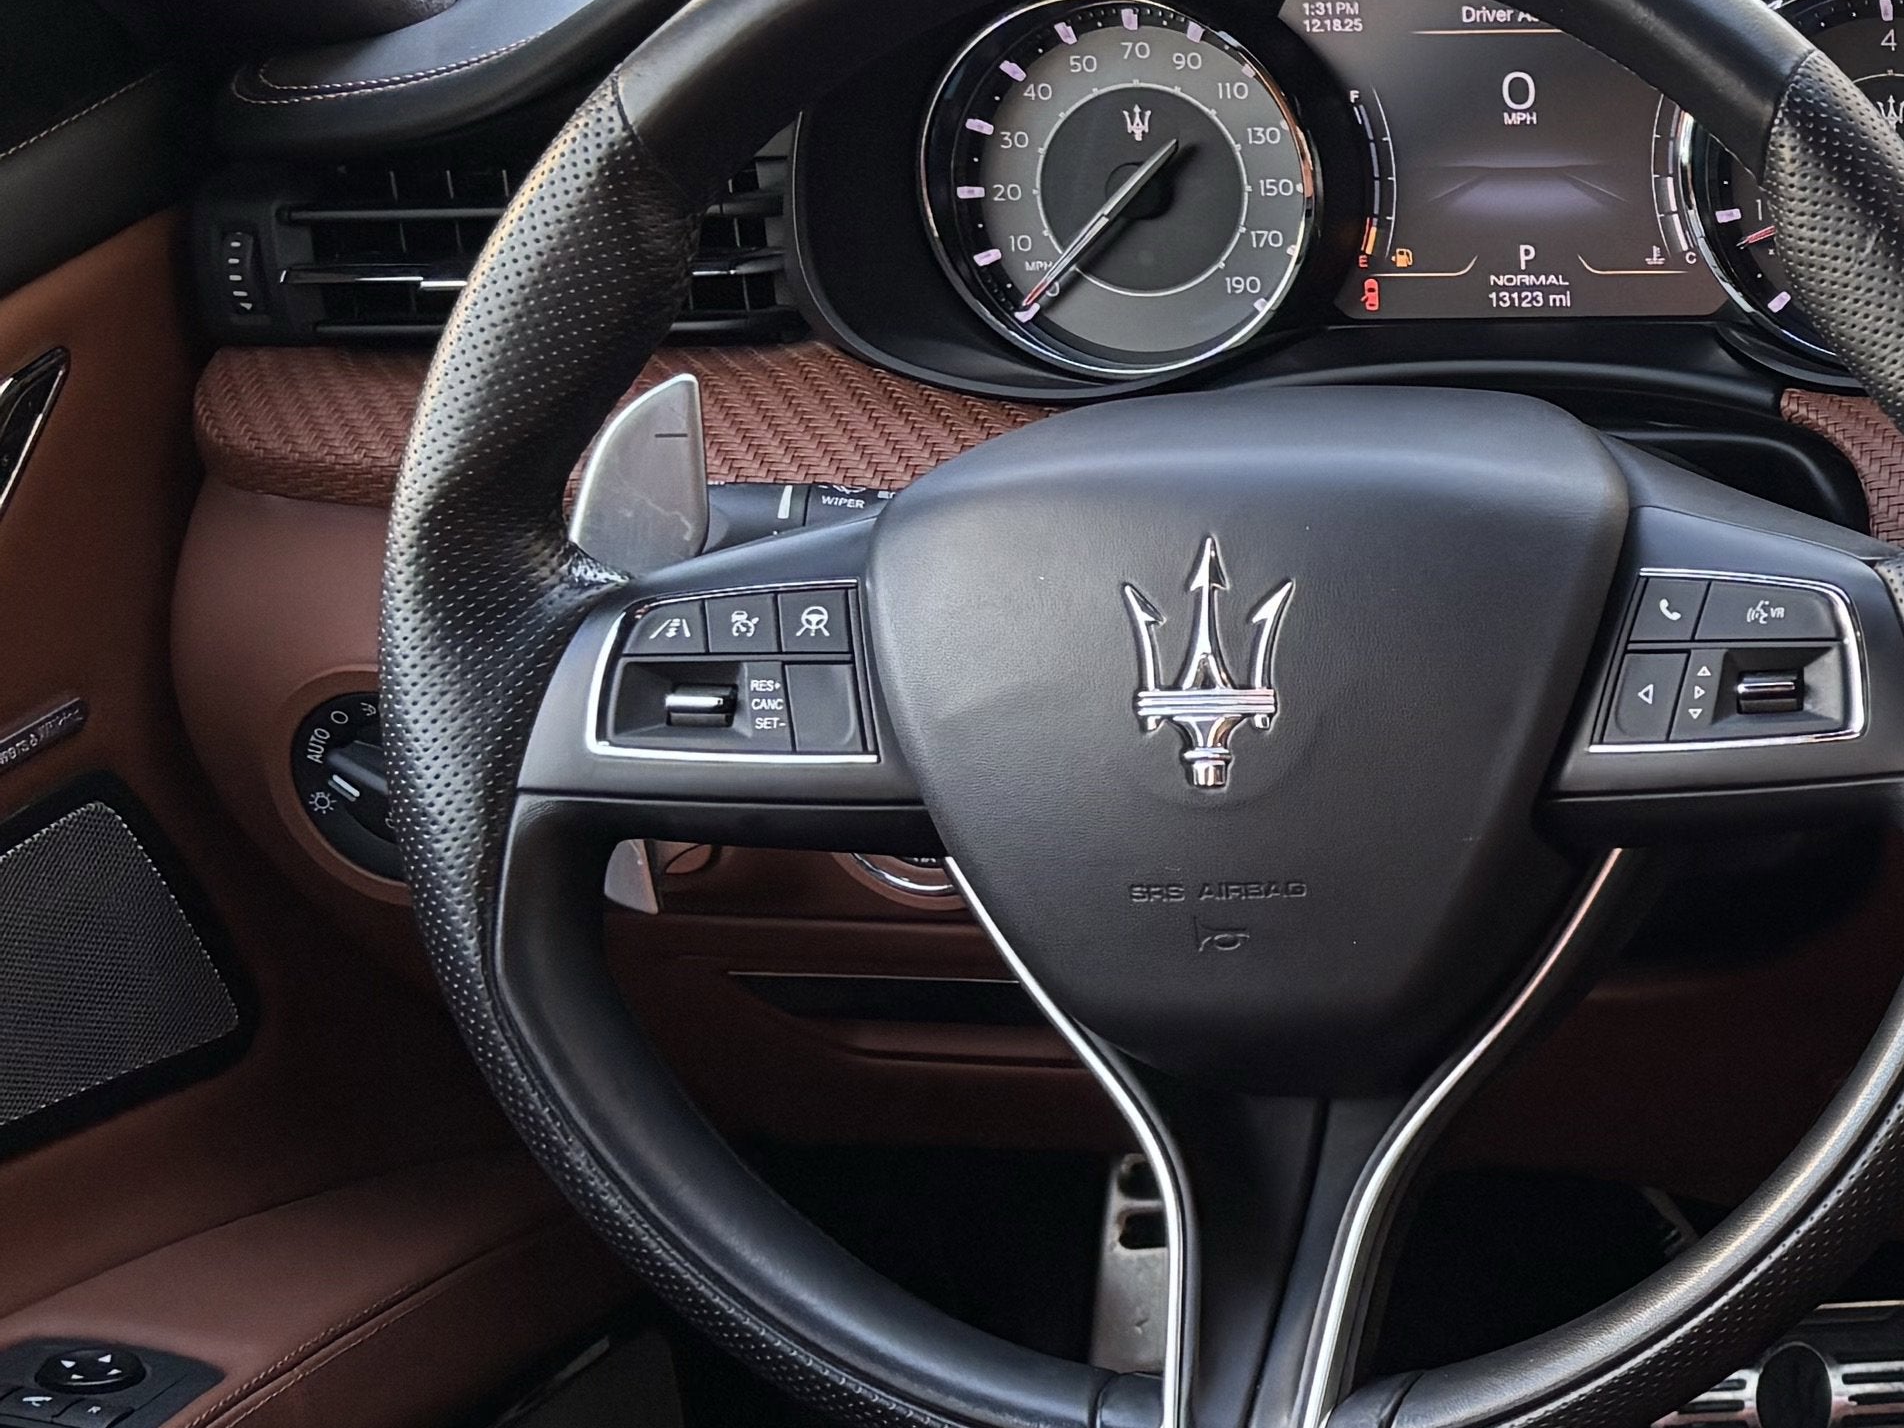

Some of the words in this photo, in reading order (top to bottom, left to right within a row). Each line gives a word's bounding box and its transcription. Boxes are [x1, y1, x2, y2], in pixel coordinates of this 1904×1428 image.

[1303, 2, 1334, 16] 1:31
[1336, 2, 1359, 15] PM
[1462, 6, 1513, 23] Driver
[1303, 19, 1363, 33] 12.18.25
[1881, 29, 1898, 52] 4
[1121, 42, 1150, 59] 70
[1069, 55, 1098, 73] 50
[1172, 52, 1202, 70] 90
[1023, 83, 1052, 101] 40
[1216, 81, 1248, 100] 110
[1350, 90, 1360, 104] F
[1501, 71, 1536, 110] 0
[1503, 112, 1537, 125] MPH
[1000, 131, 1029, 149] 30
[1248, 127, 1281, 145] 130
[993, 184, 1022, 201] 20
[1259, 178, 1294, 196] 150
[1009, 235, 1032, 252] 10
[1250, 230, 1283, 248] 170
[1519, 244, 1536, 271] P
[1225, 276, 1261, 294] 190
[1490, 274, 1569, 287] NORMAL
[1488, 291, 1543, 308] 13123
[1549, 291, 1571, 308] mi
[821, 494, 866, 510] WIPER
[751, 698, 784, 710] CANC
[306, 727, 331, 764] AUTO
[1131, 884, 1186, 903] SRS
[1199, 881, 1308, 901] AIRBAG
